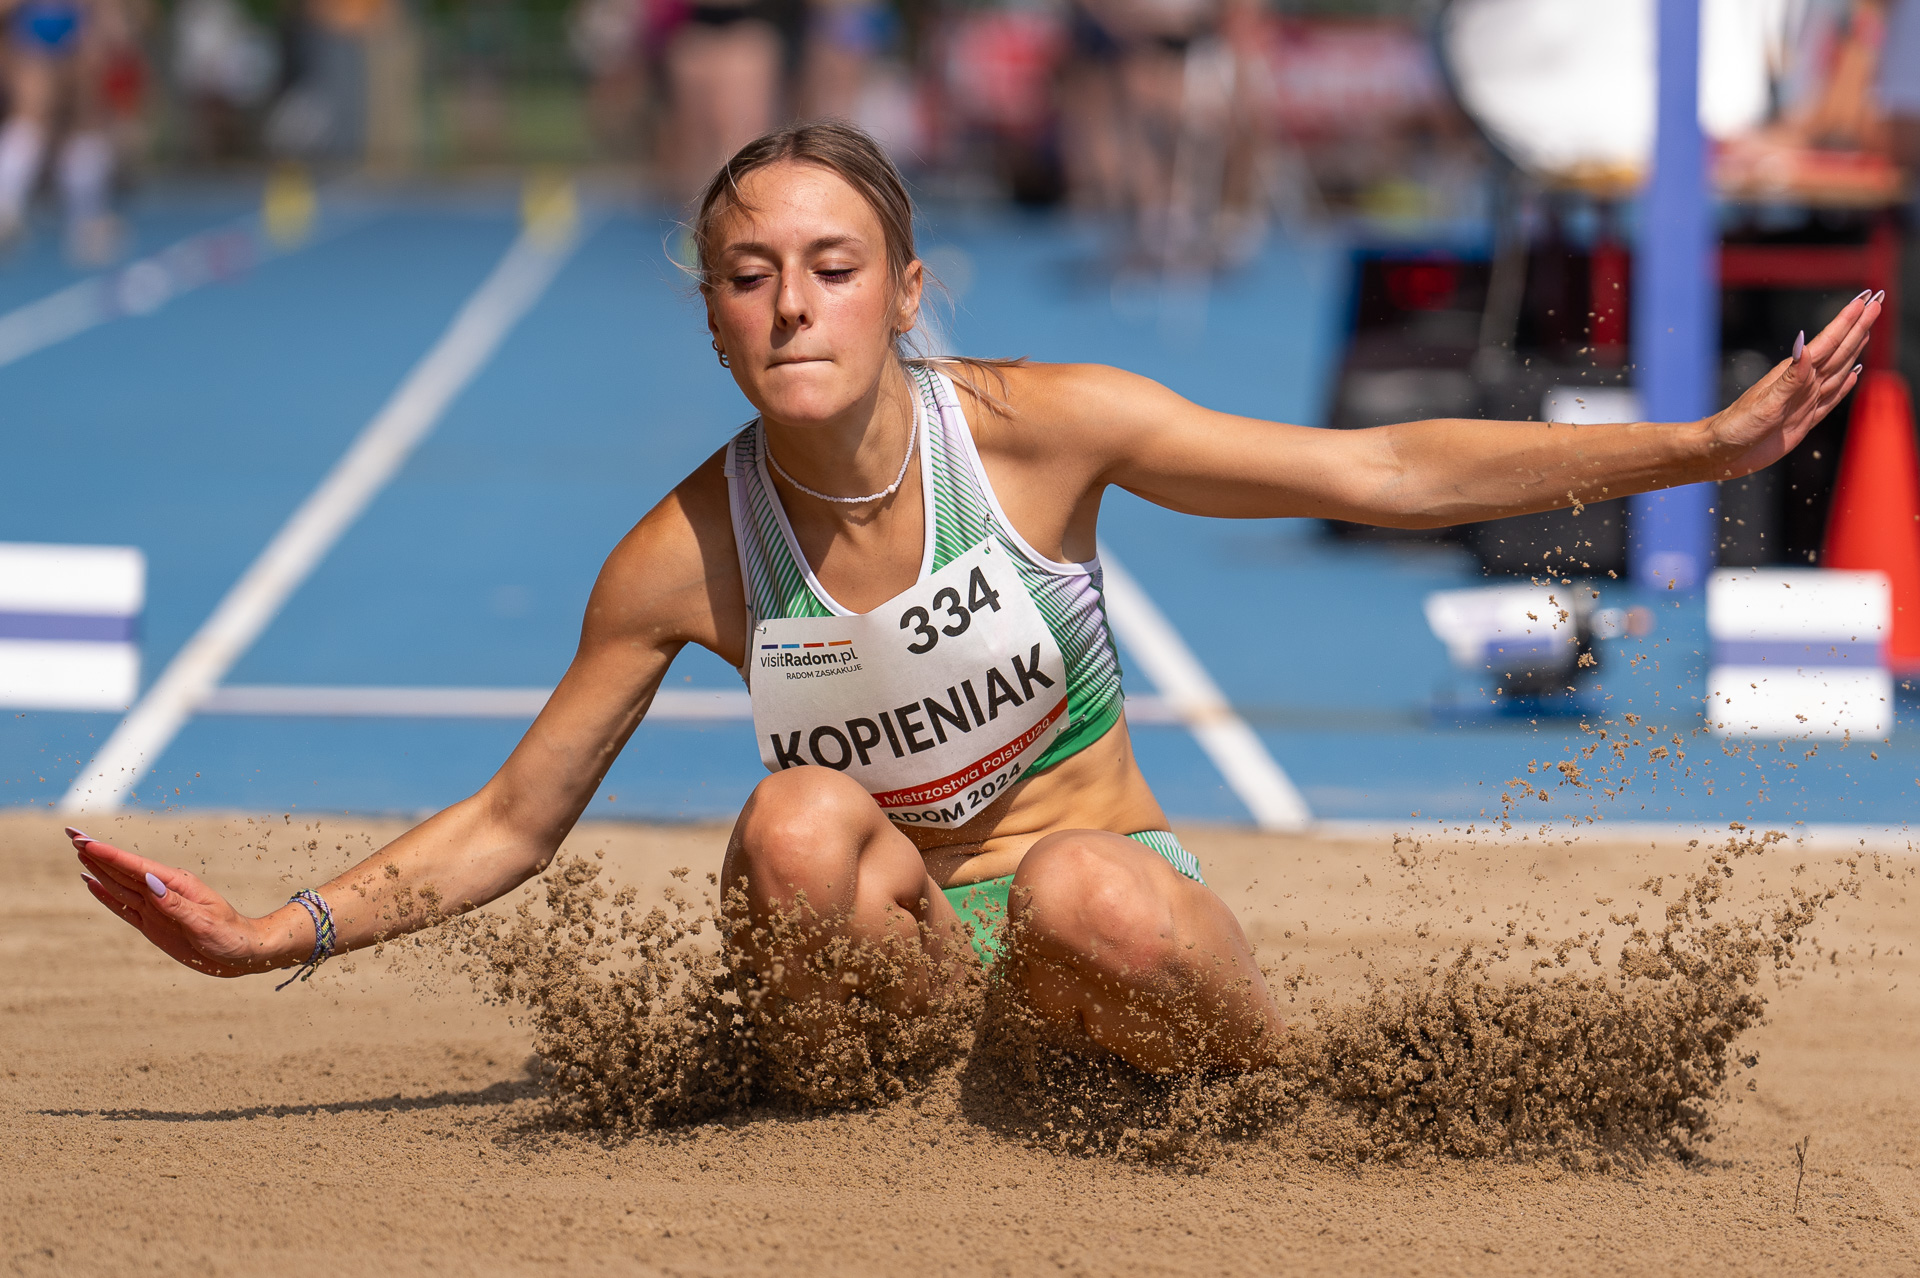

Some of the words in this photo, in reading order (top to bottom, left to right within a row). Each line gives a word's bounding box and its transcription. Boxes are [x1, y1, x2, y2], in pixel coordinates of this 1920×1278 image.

[900, 566, 1001, 655] 334
[760, 647, 859, 668] visitRadom.pl
[786, 671, 815, 680] RADOM
[815, 664, 863, 678] ZASKAKUJE
[770, 642, 1056, 772] KOPIENIAK
[883, 769, 981, 805] Mistrzostwa
[982, 739, 1024, 773] Polski
[1026, 718, 1050, 743] U20
[887, 801, 965, 823] ADOM
[967, 762, 1021, 809] 2024
